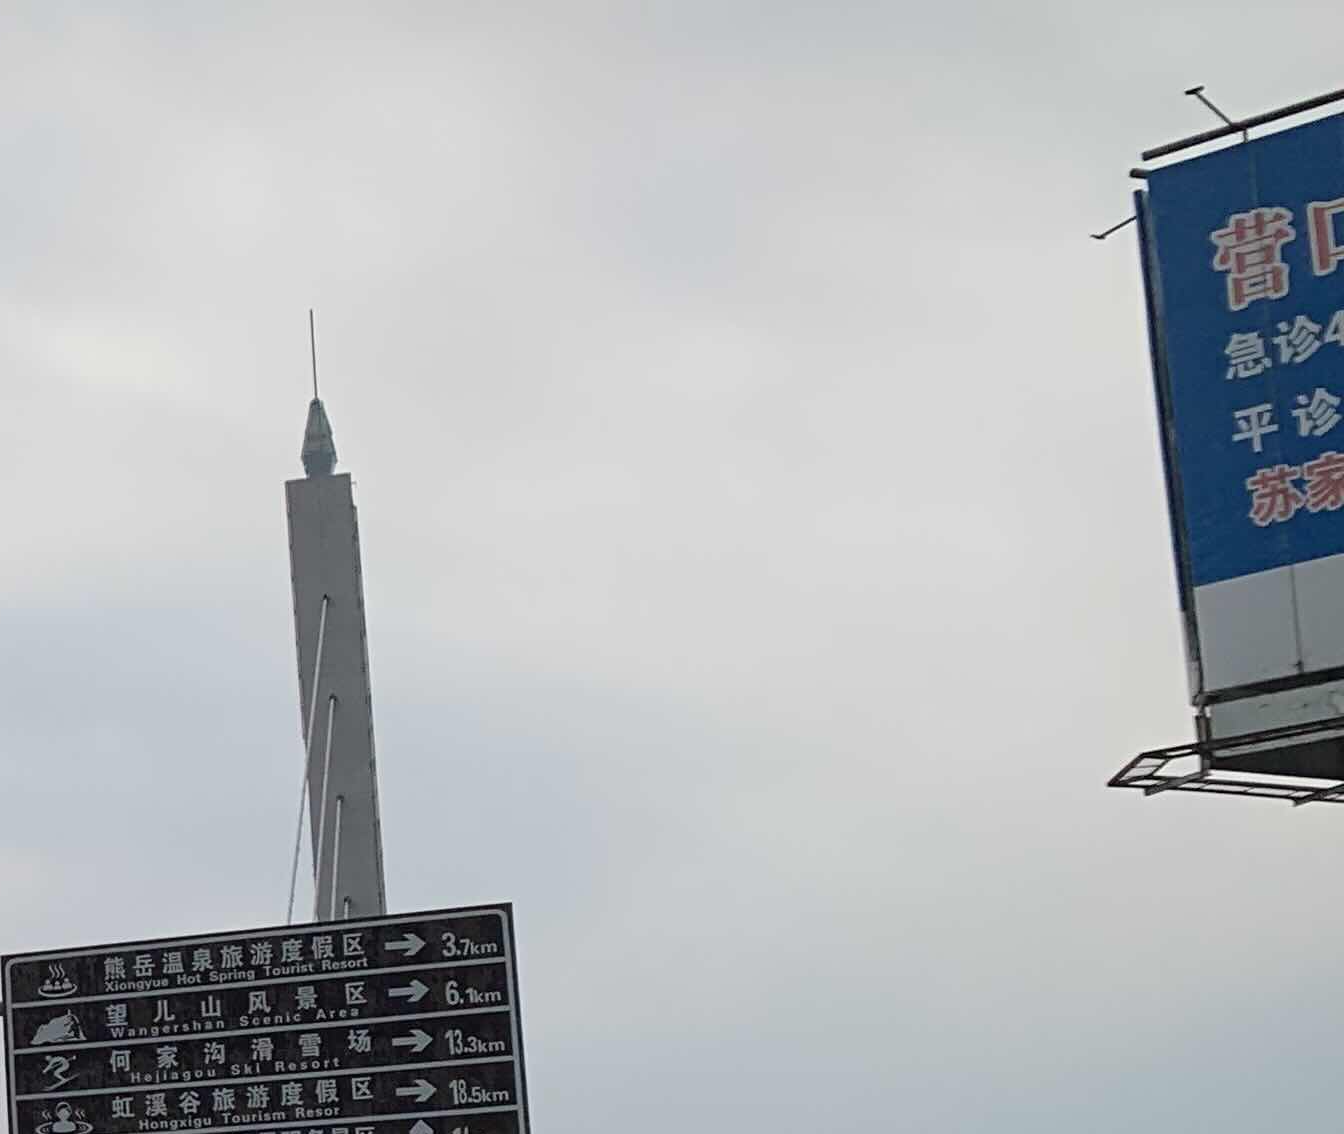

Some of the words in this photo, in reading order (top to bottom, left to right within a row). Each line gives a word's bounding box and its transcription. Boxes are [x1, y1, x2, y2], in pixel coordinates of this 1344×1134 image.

[1232, 388, 1343, 452] 平诊
[104, 933, 365, 981] 熊岳温泉旅游度假区
[441, 932, 498, 957] 3.7km
[104, 979, 169, 993] Xiongyue
[177, 974, 202, 986] Hot
[210, 969, 255, 984] Spring
[265, 964, 313, 977] Tourist
[321, 957, 368, 971] Resort
[105, 981, 367, 1027] 望儿山风景区
[111, 1019, 224, 1039] Wangershan
[239, 1012, 301, 1027] Scenic
[315, 1007, 359, 1020] Area
[110, 1029, 372, 1073] 何家沟滑雪场
[444, 1029, 505, 1055] 13.3km
[130, 1068, 216, 1084] Hejiagou
[230, 1063, 260, 1076] Ski
[274, 1057, 340, 1072] Resort
[112, 1077, 373, 1119] 虹溪谷旅游度假区
[139, 1116, 212, 1132] Hongxigu
[222, 1110, 286, 1124] Tourism
